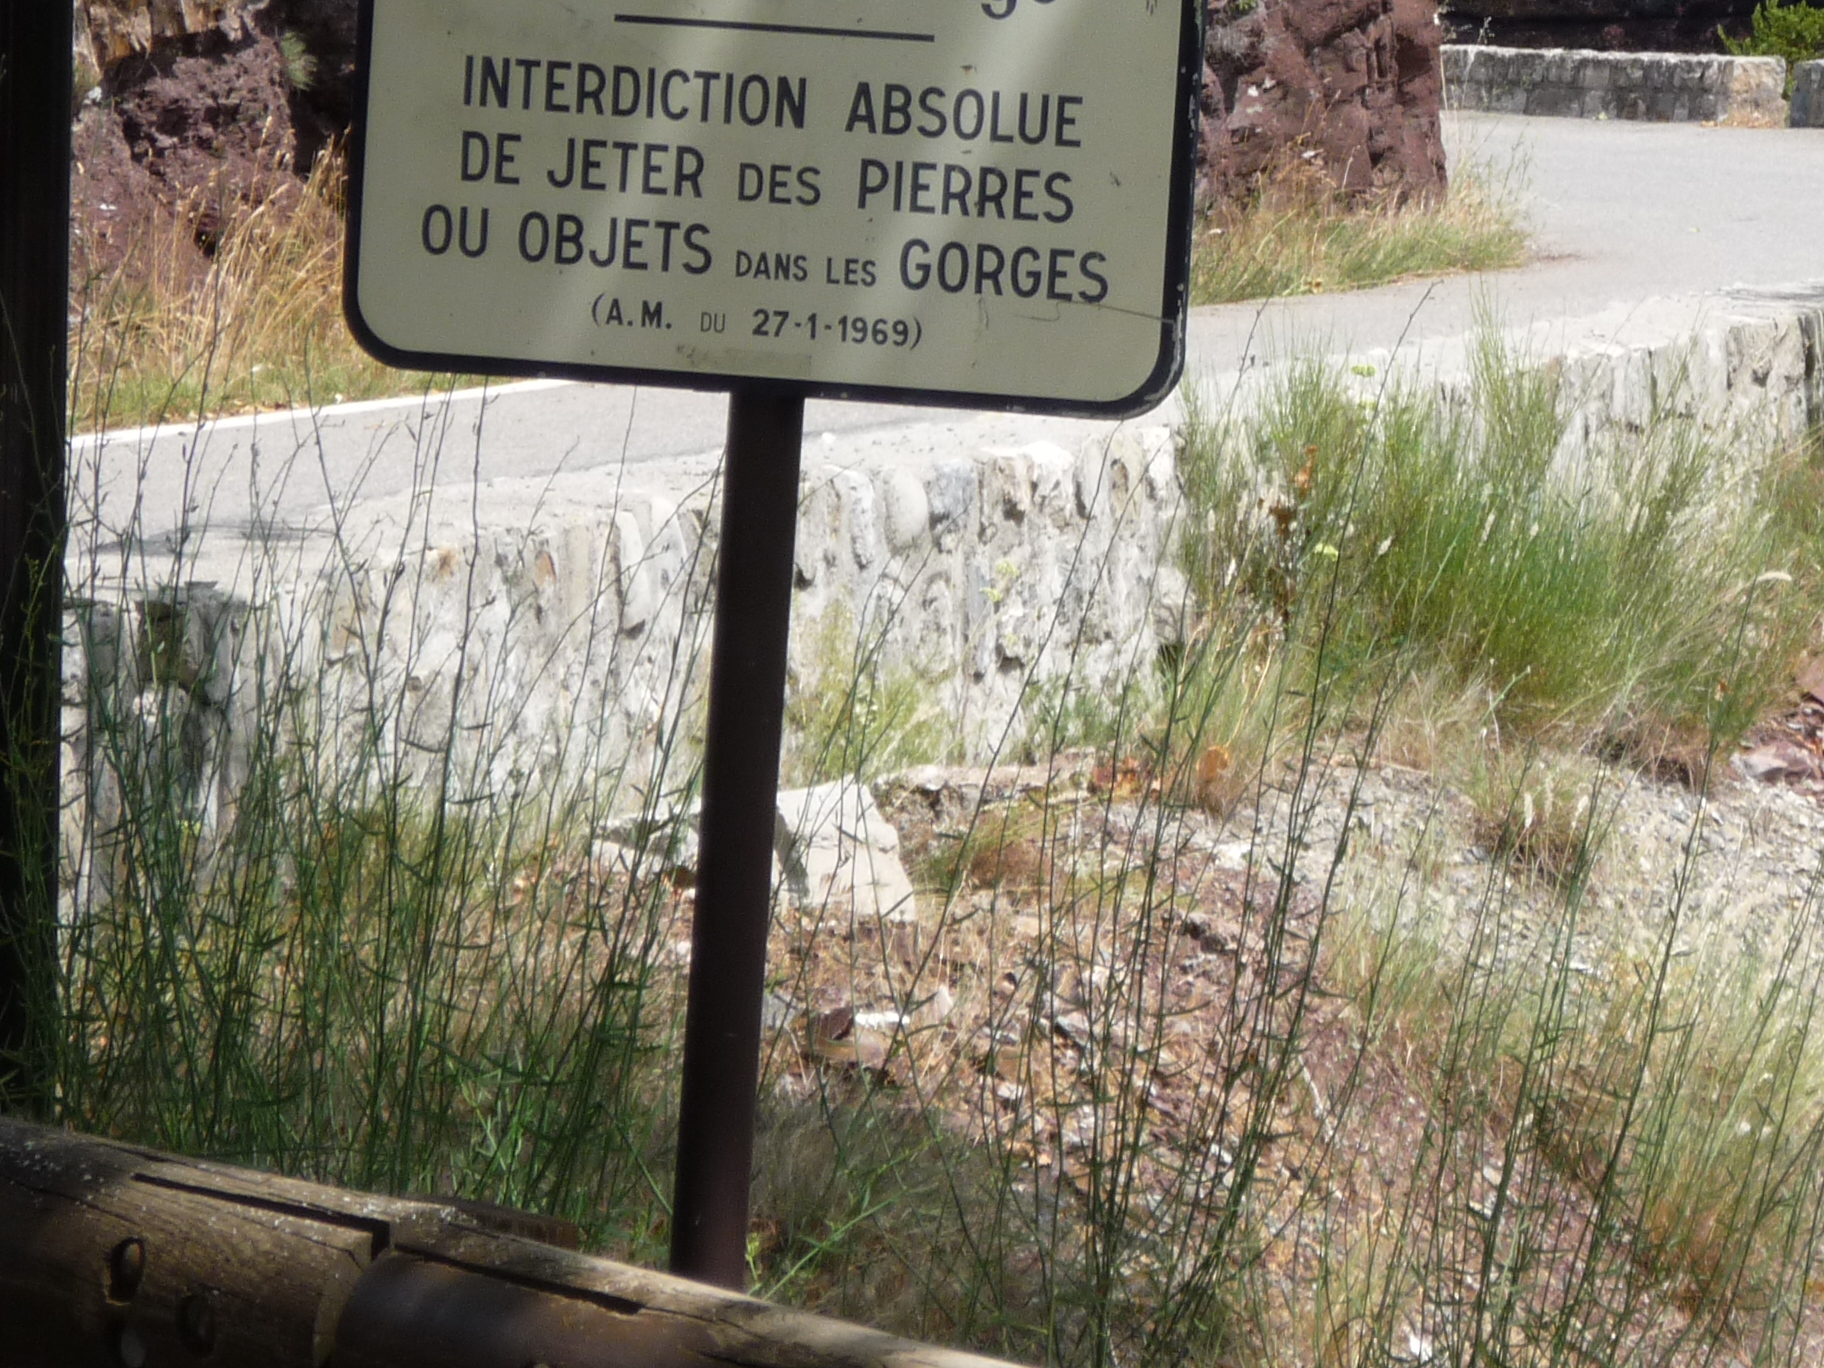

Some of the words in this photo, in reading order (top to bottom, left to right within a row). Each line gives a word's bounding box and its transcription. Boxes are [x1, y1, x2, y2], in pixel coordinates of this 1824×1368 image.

[464, 55, 807, 129] INTERDICTION
[845, 82, 1083, 148] ABSOLUE
[461, 131, 521, 185] DE
[547, 138, 704, 198] JETER
[738, 163, 821, 206] DES
[858, 158, 1073, 223] PIERRES
[422, 204, 489, 258] OU
[519, 211, 712, 275] OBJETS
[736, 250, 808, 282] DANS
[826, 257, 876, 286] LES
[900, 239, 1108, 306] GORGES
[592, 294, 671, 329] (A.M.
[701, 312, 725, 333] DU
[752, 309, 922, 350] 27-1-1969)
